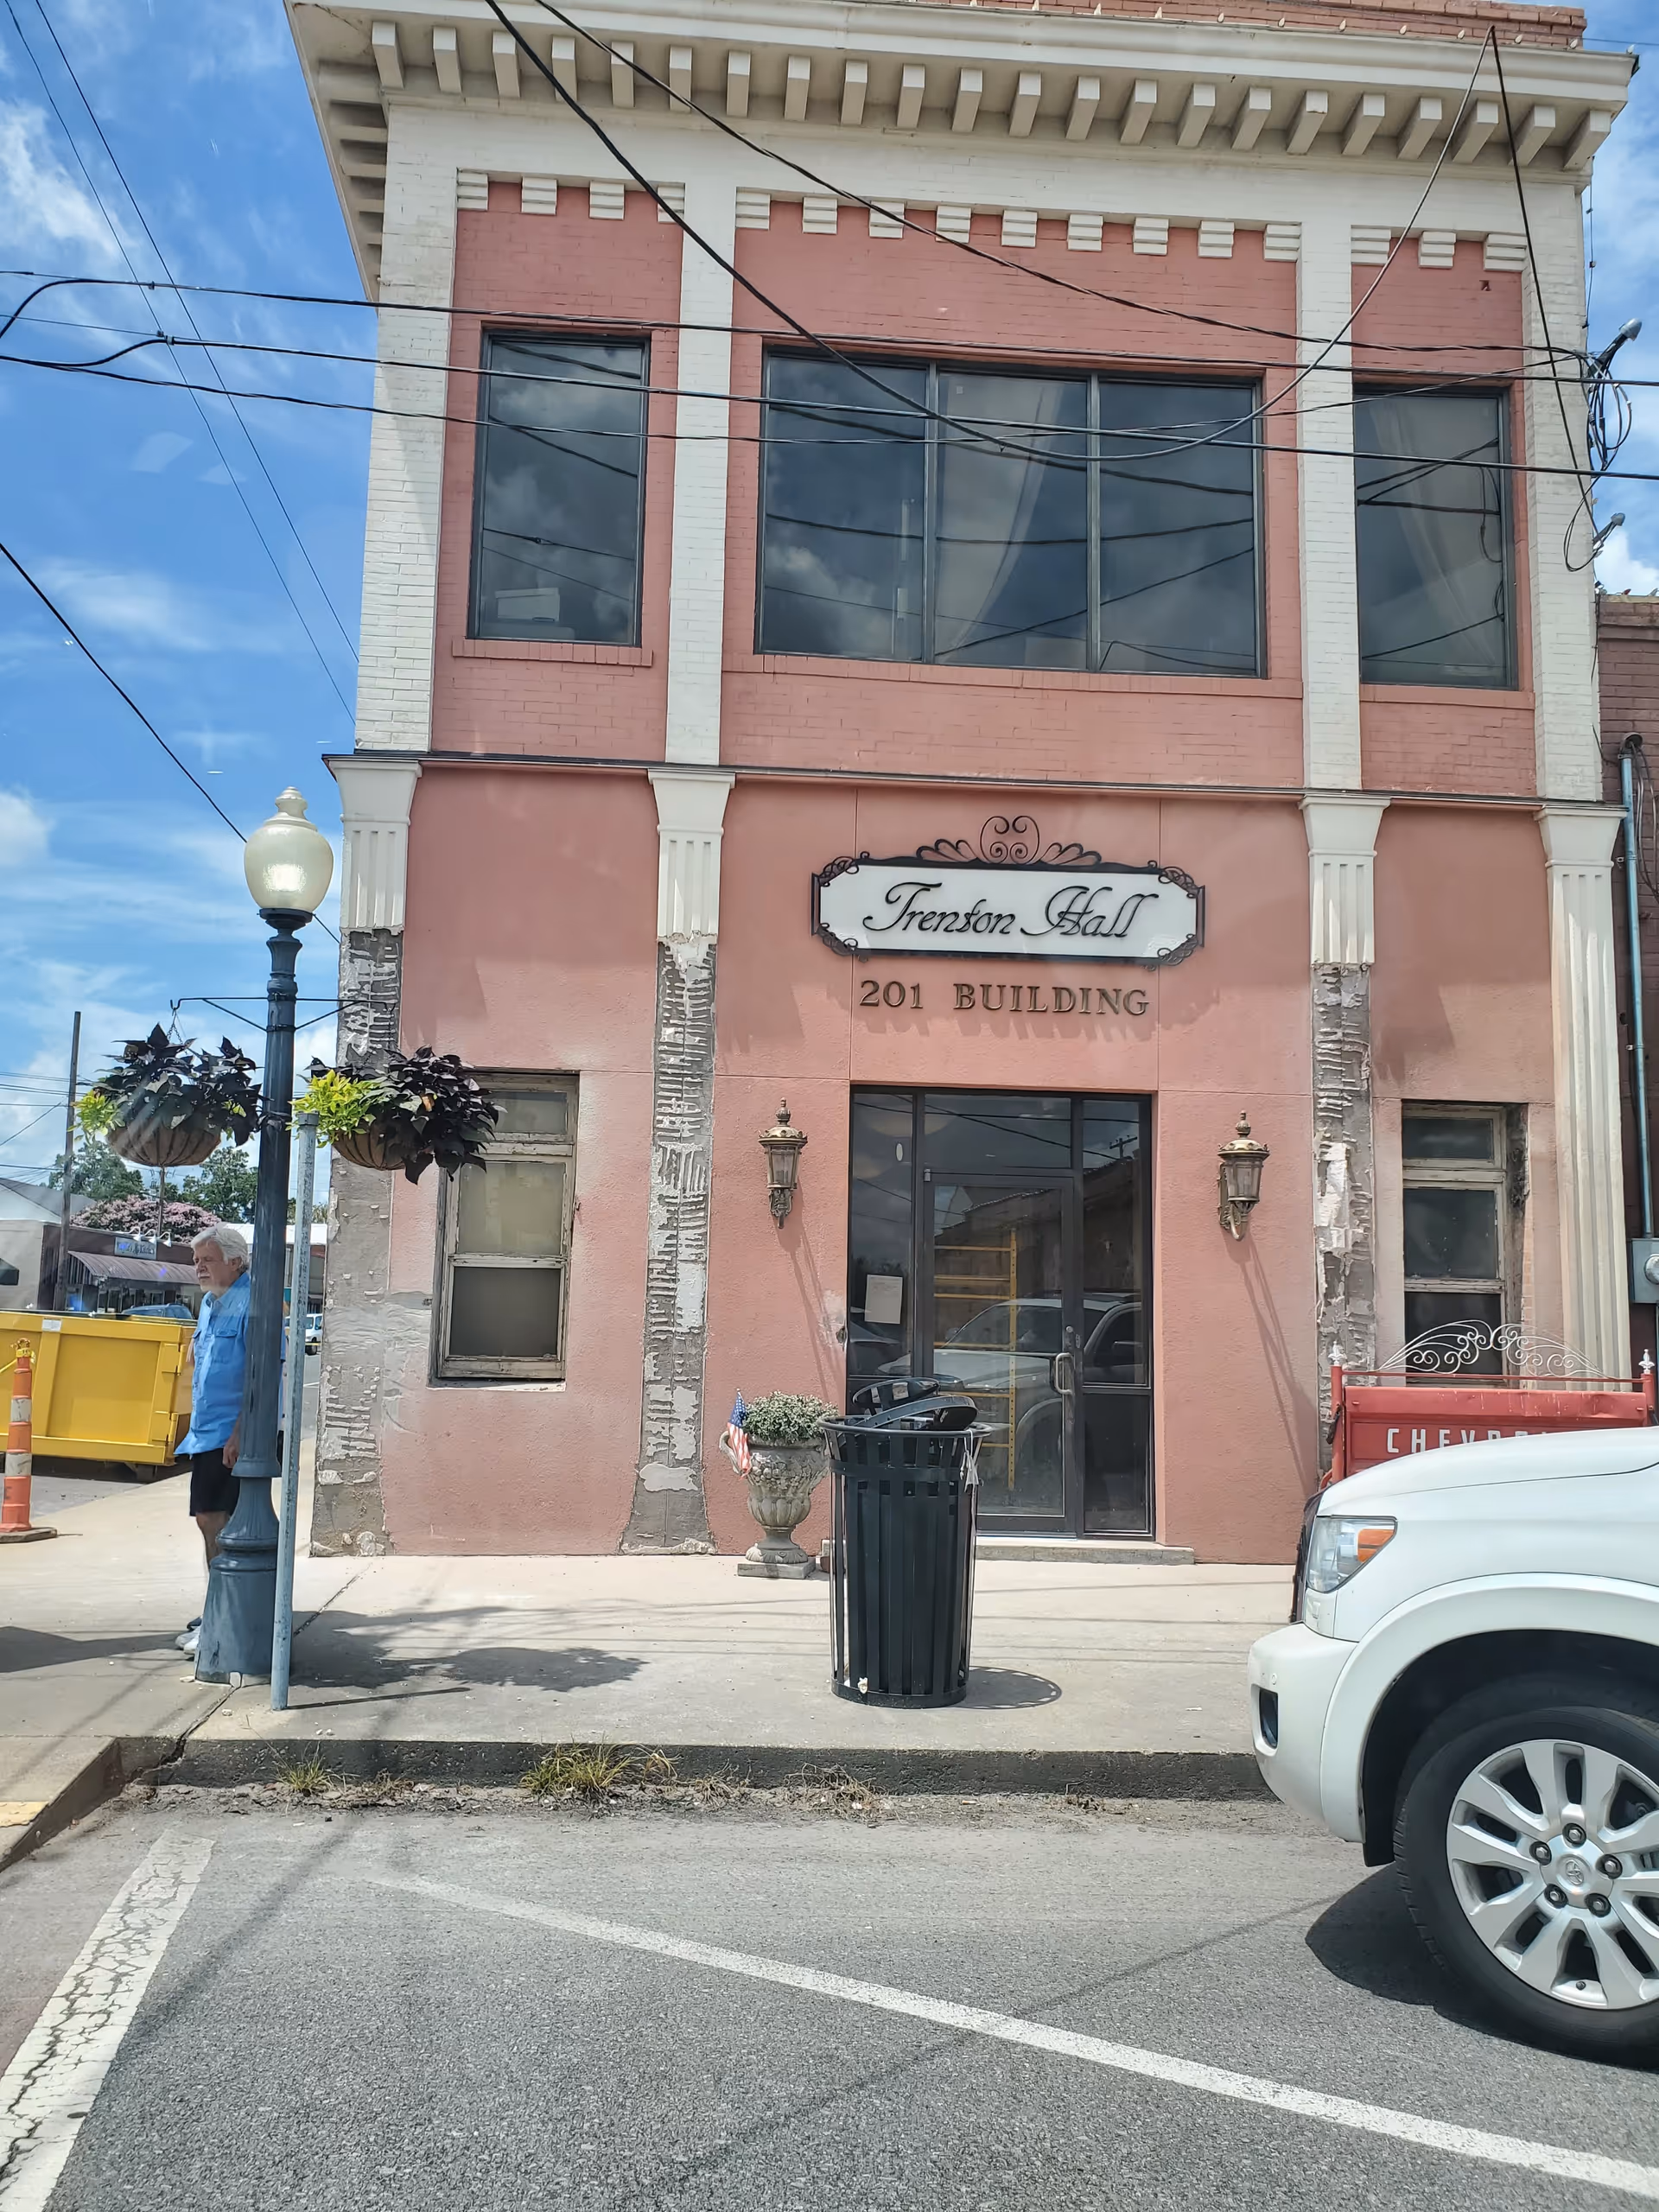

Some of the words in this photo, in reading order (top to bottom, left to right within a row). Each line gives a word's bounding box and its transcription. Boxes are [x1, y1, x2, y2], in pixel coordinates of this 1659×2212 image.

[862, 881, 1016, 935] Trenton
[1020, 886, 1160, 938] Hall
[859, 980, 924, 1009] 201
[953, 982, 1151, 1016] BUILDING
[1387, 1428, 1547, 1453] CHEV
